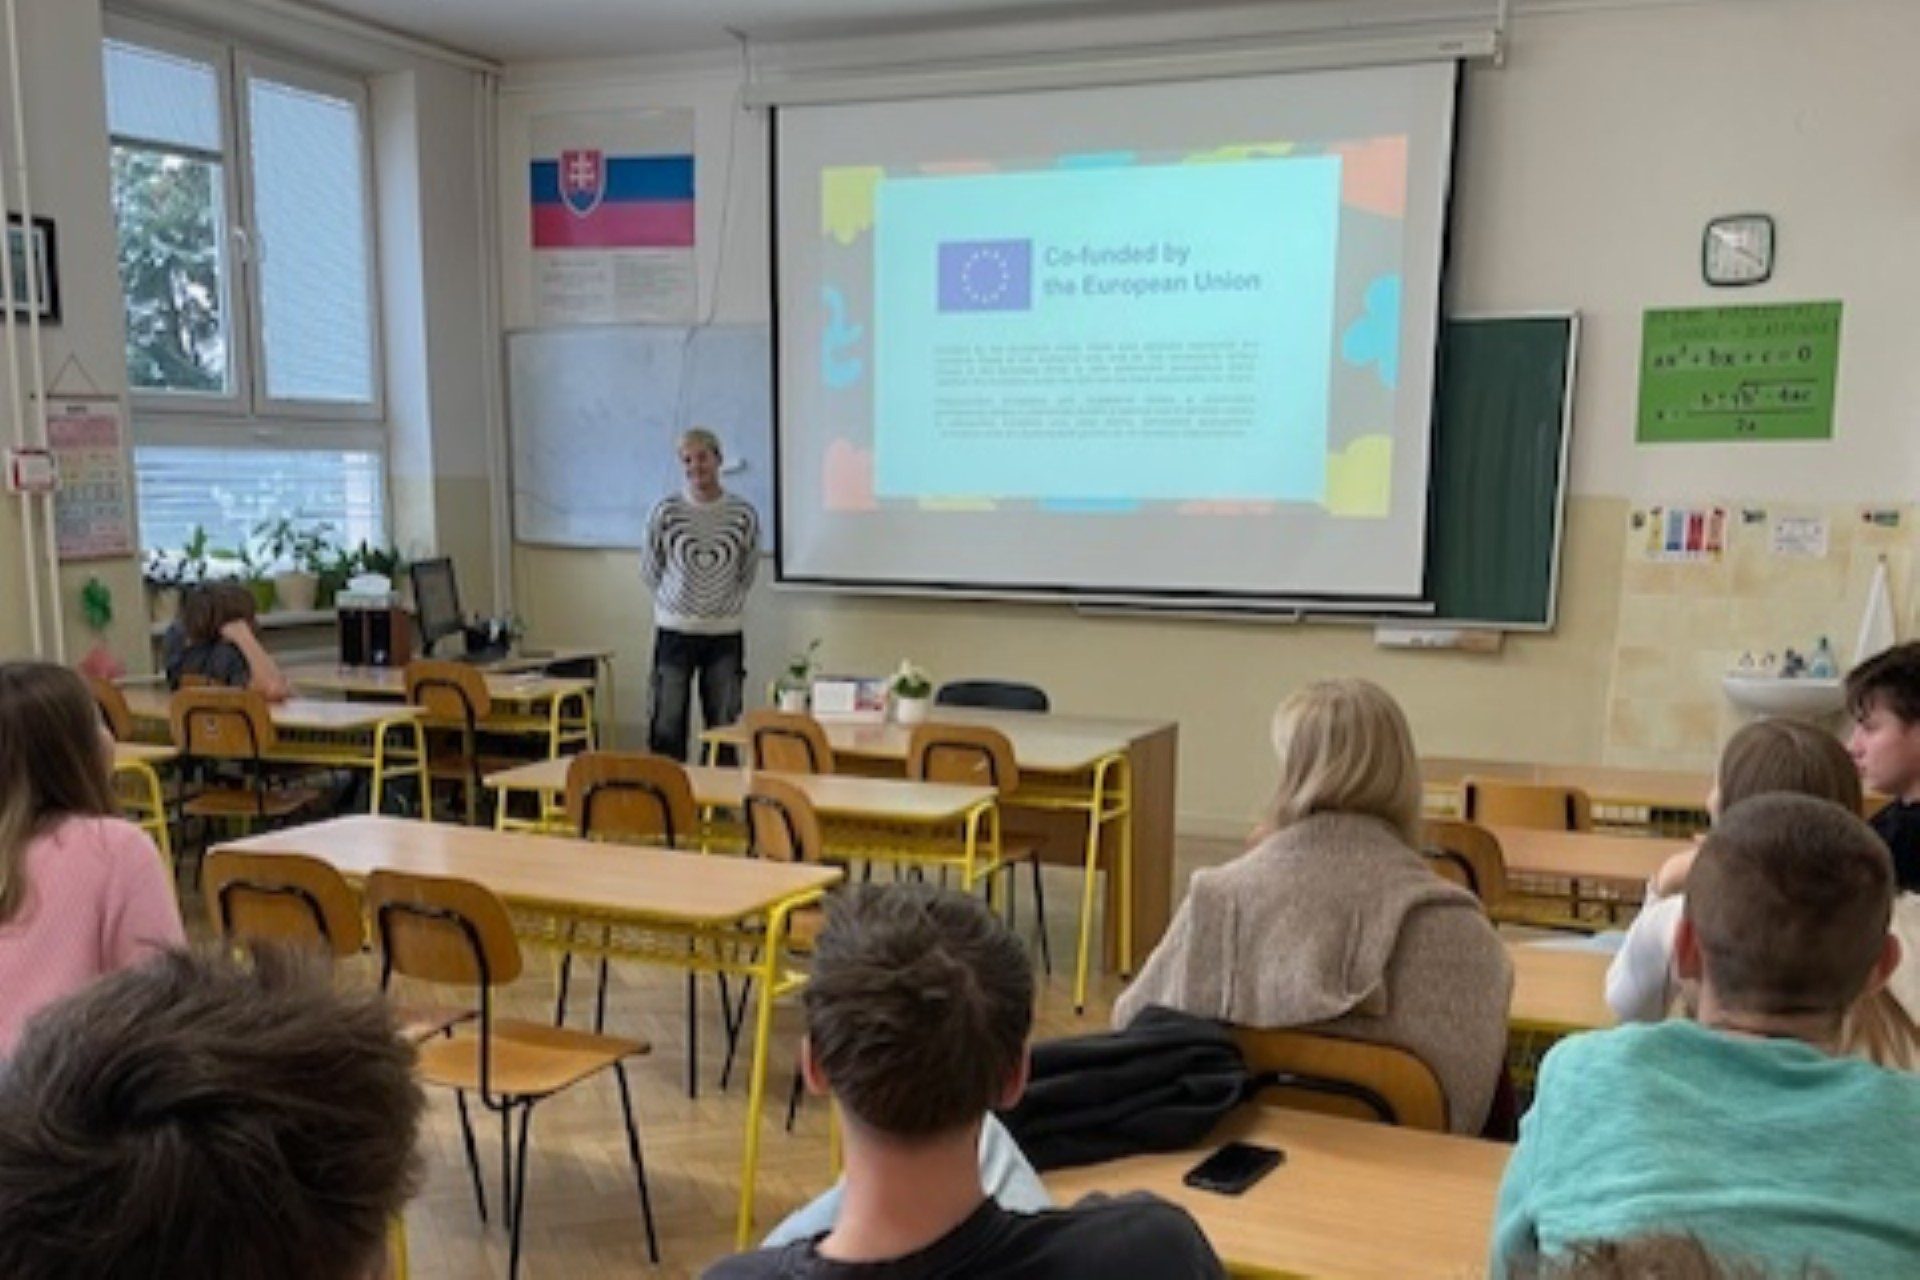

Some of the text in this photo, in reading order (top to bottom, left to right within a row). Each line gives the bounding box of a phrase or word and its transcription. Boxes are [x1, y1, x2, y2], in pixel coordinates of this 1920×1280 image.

[1044, 242, 1190, 267] Co-funded by
[1042, 269, 1261, 299] the European Union
